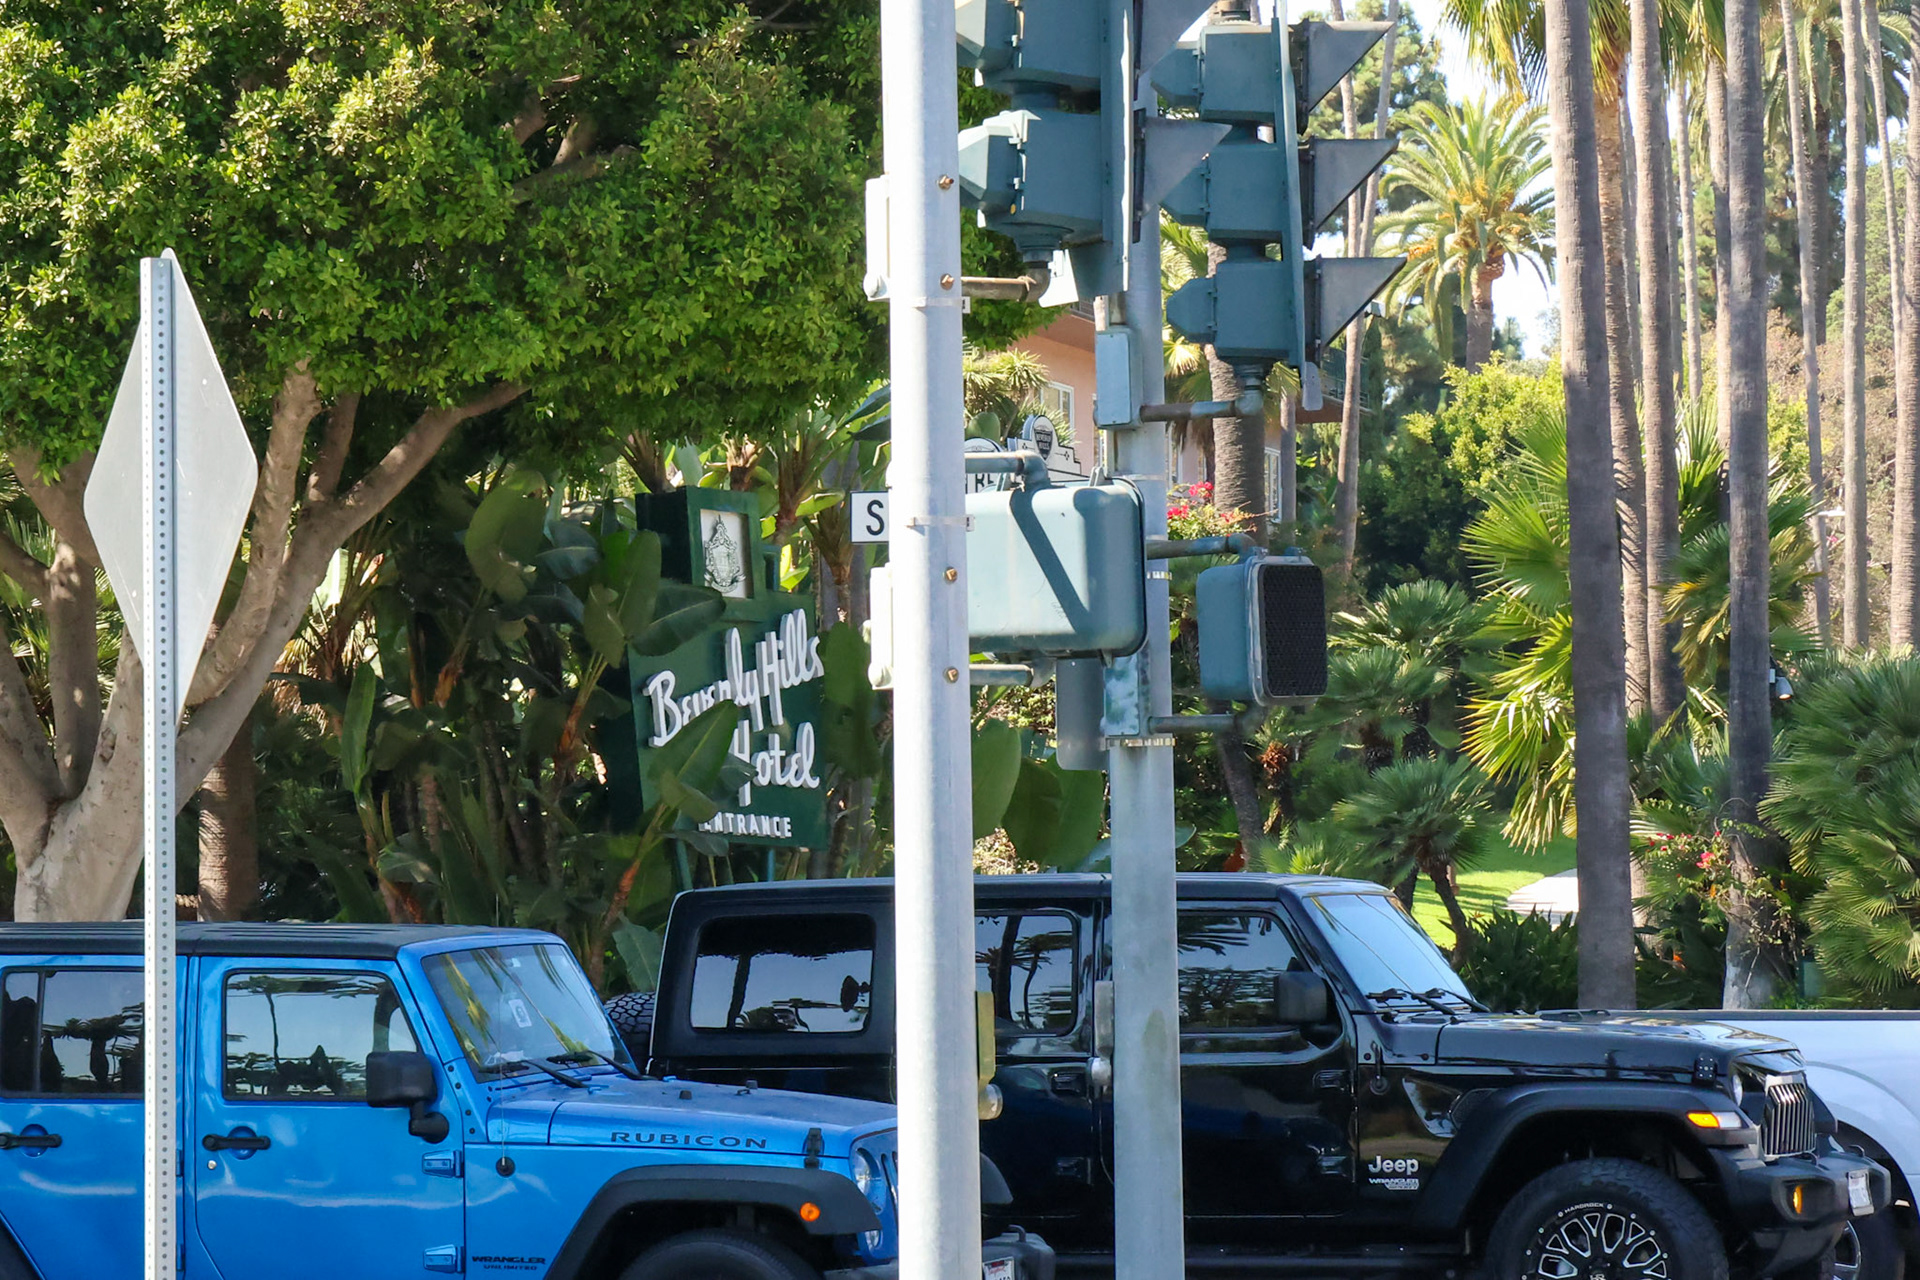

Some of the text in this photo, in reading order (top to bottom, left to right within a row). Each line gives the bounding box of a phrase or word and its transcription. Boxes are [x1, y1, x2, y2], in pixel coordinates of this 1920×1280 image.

[755, 608, 825, 726] Hills
[611, 1132, 767, 1148] RUBICON
[1368, 1155, 1419, 1175] Jeep
[472, 1256, 546, 1264] WRANGLER
